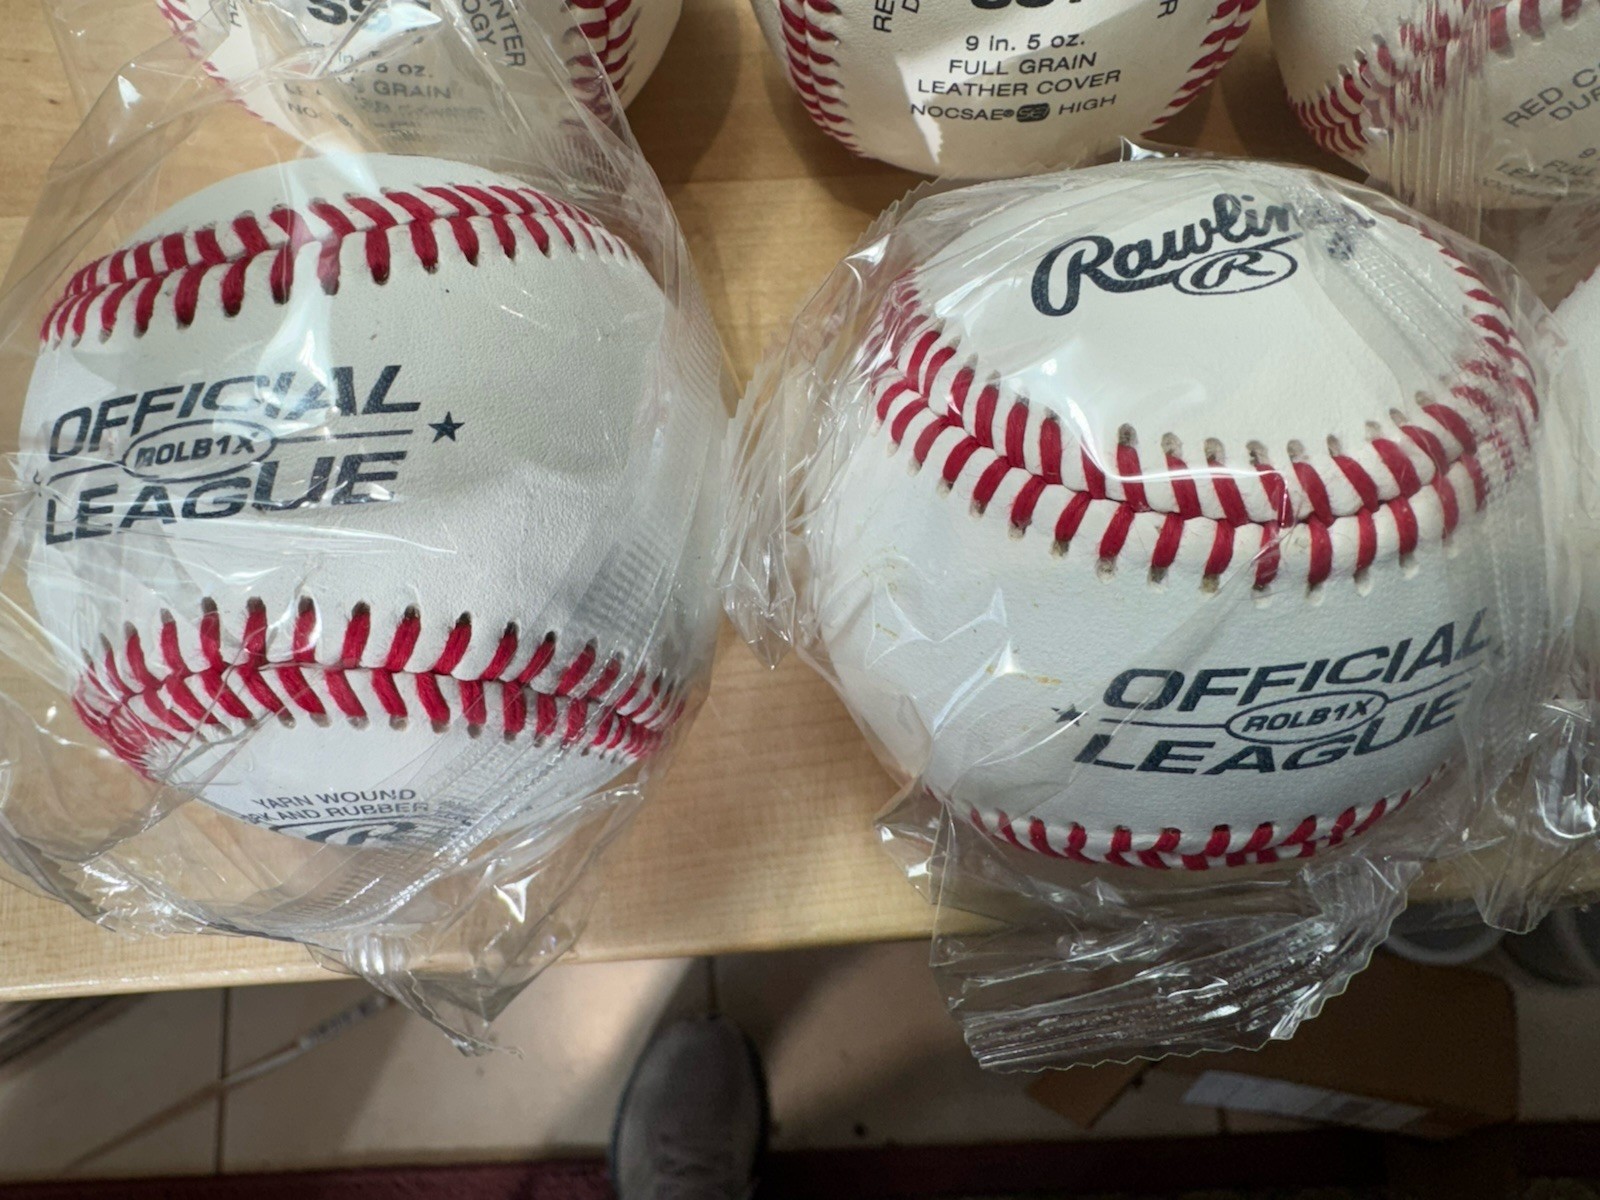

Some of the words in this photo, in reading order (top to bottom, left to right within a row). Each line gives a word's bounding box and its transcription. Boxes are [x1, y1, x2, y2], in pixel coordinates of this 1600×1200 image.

[965, 35, 979, 52] 9
[989, 34, 1016, 51] in.
[1027, 33, 1042, 50] 5
[1051, 33, 1086, 48] oz.
[949, 59, 1009, 75] FULL
[1018, 52, 1097, 75] GRAIN
[917, 78, 1029, 98] LEATHER
[1036, 69, 1121, 95] COVER
[1057, 95, 1117, 116] HIGH
[1502, 86, 1564, 128] RED
[48, 364, 421, 462] OFFICIAL
[45, 450, 408, 545] LEAGUE
[1102, 606, 1492, 712] OFFICIAL
[1073, 681, 1473, 776] LEAGUE
[1241, 697, 1377, 733] ROLB1X
[252, 793, 313, 810] YARN
[316, 788, 417, 805] WOUND
[273, 809, 321, 823] AND
[327, 802, 429, 818] RUBBER
